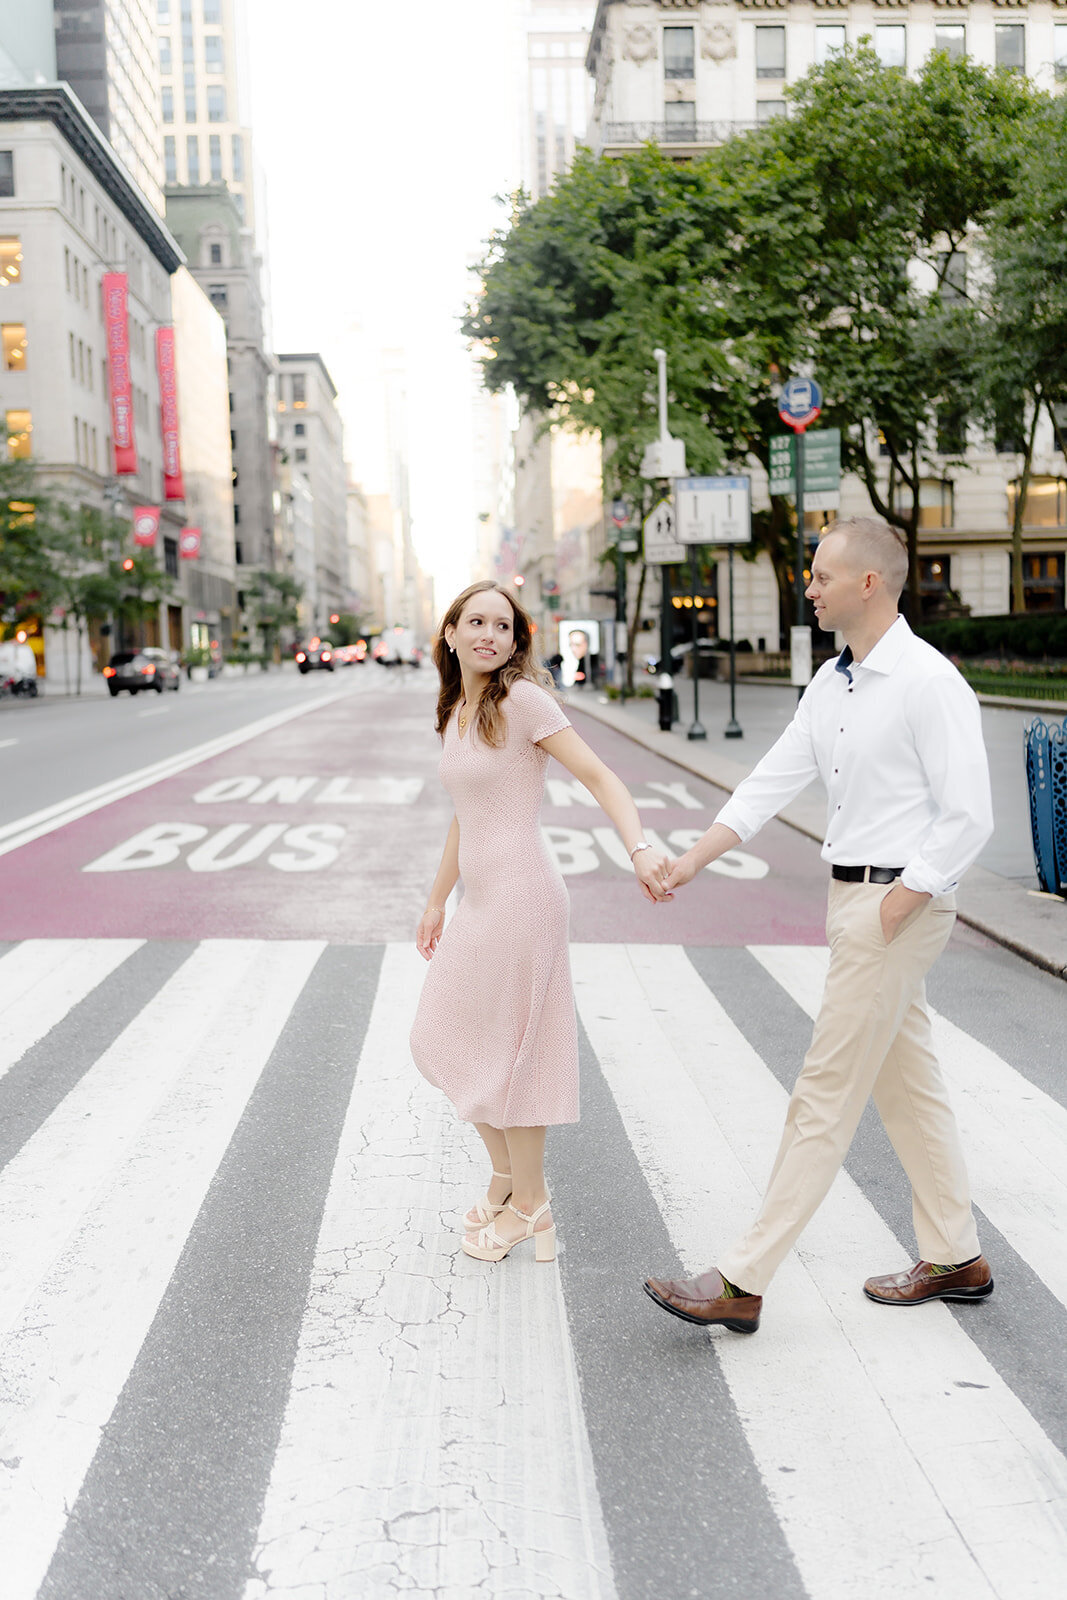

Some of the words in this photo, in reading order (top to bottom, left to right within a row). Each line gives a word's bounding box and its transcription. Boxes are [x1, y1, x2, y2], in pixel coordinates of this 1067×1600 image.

[113, 395, 130, 448] Library
[192, 775, 425, 804] ONLY
[546, 778, 705, 810] NY
[81, 822, 347, 872] BUS
[541, 825, 770, 880] BUS
